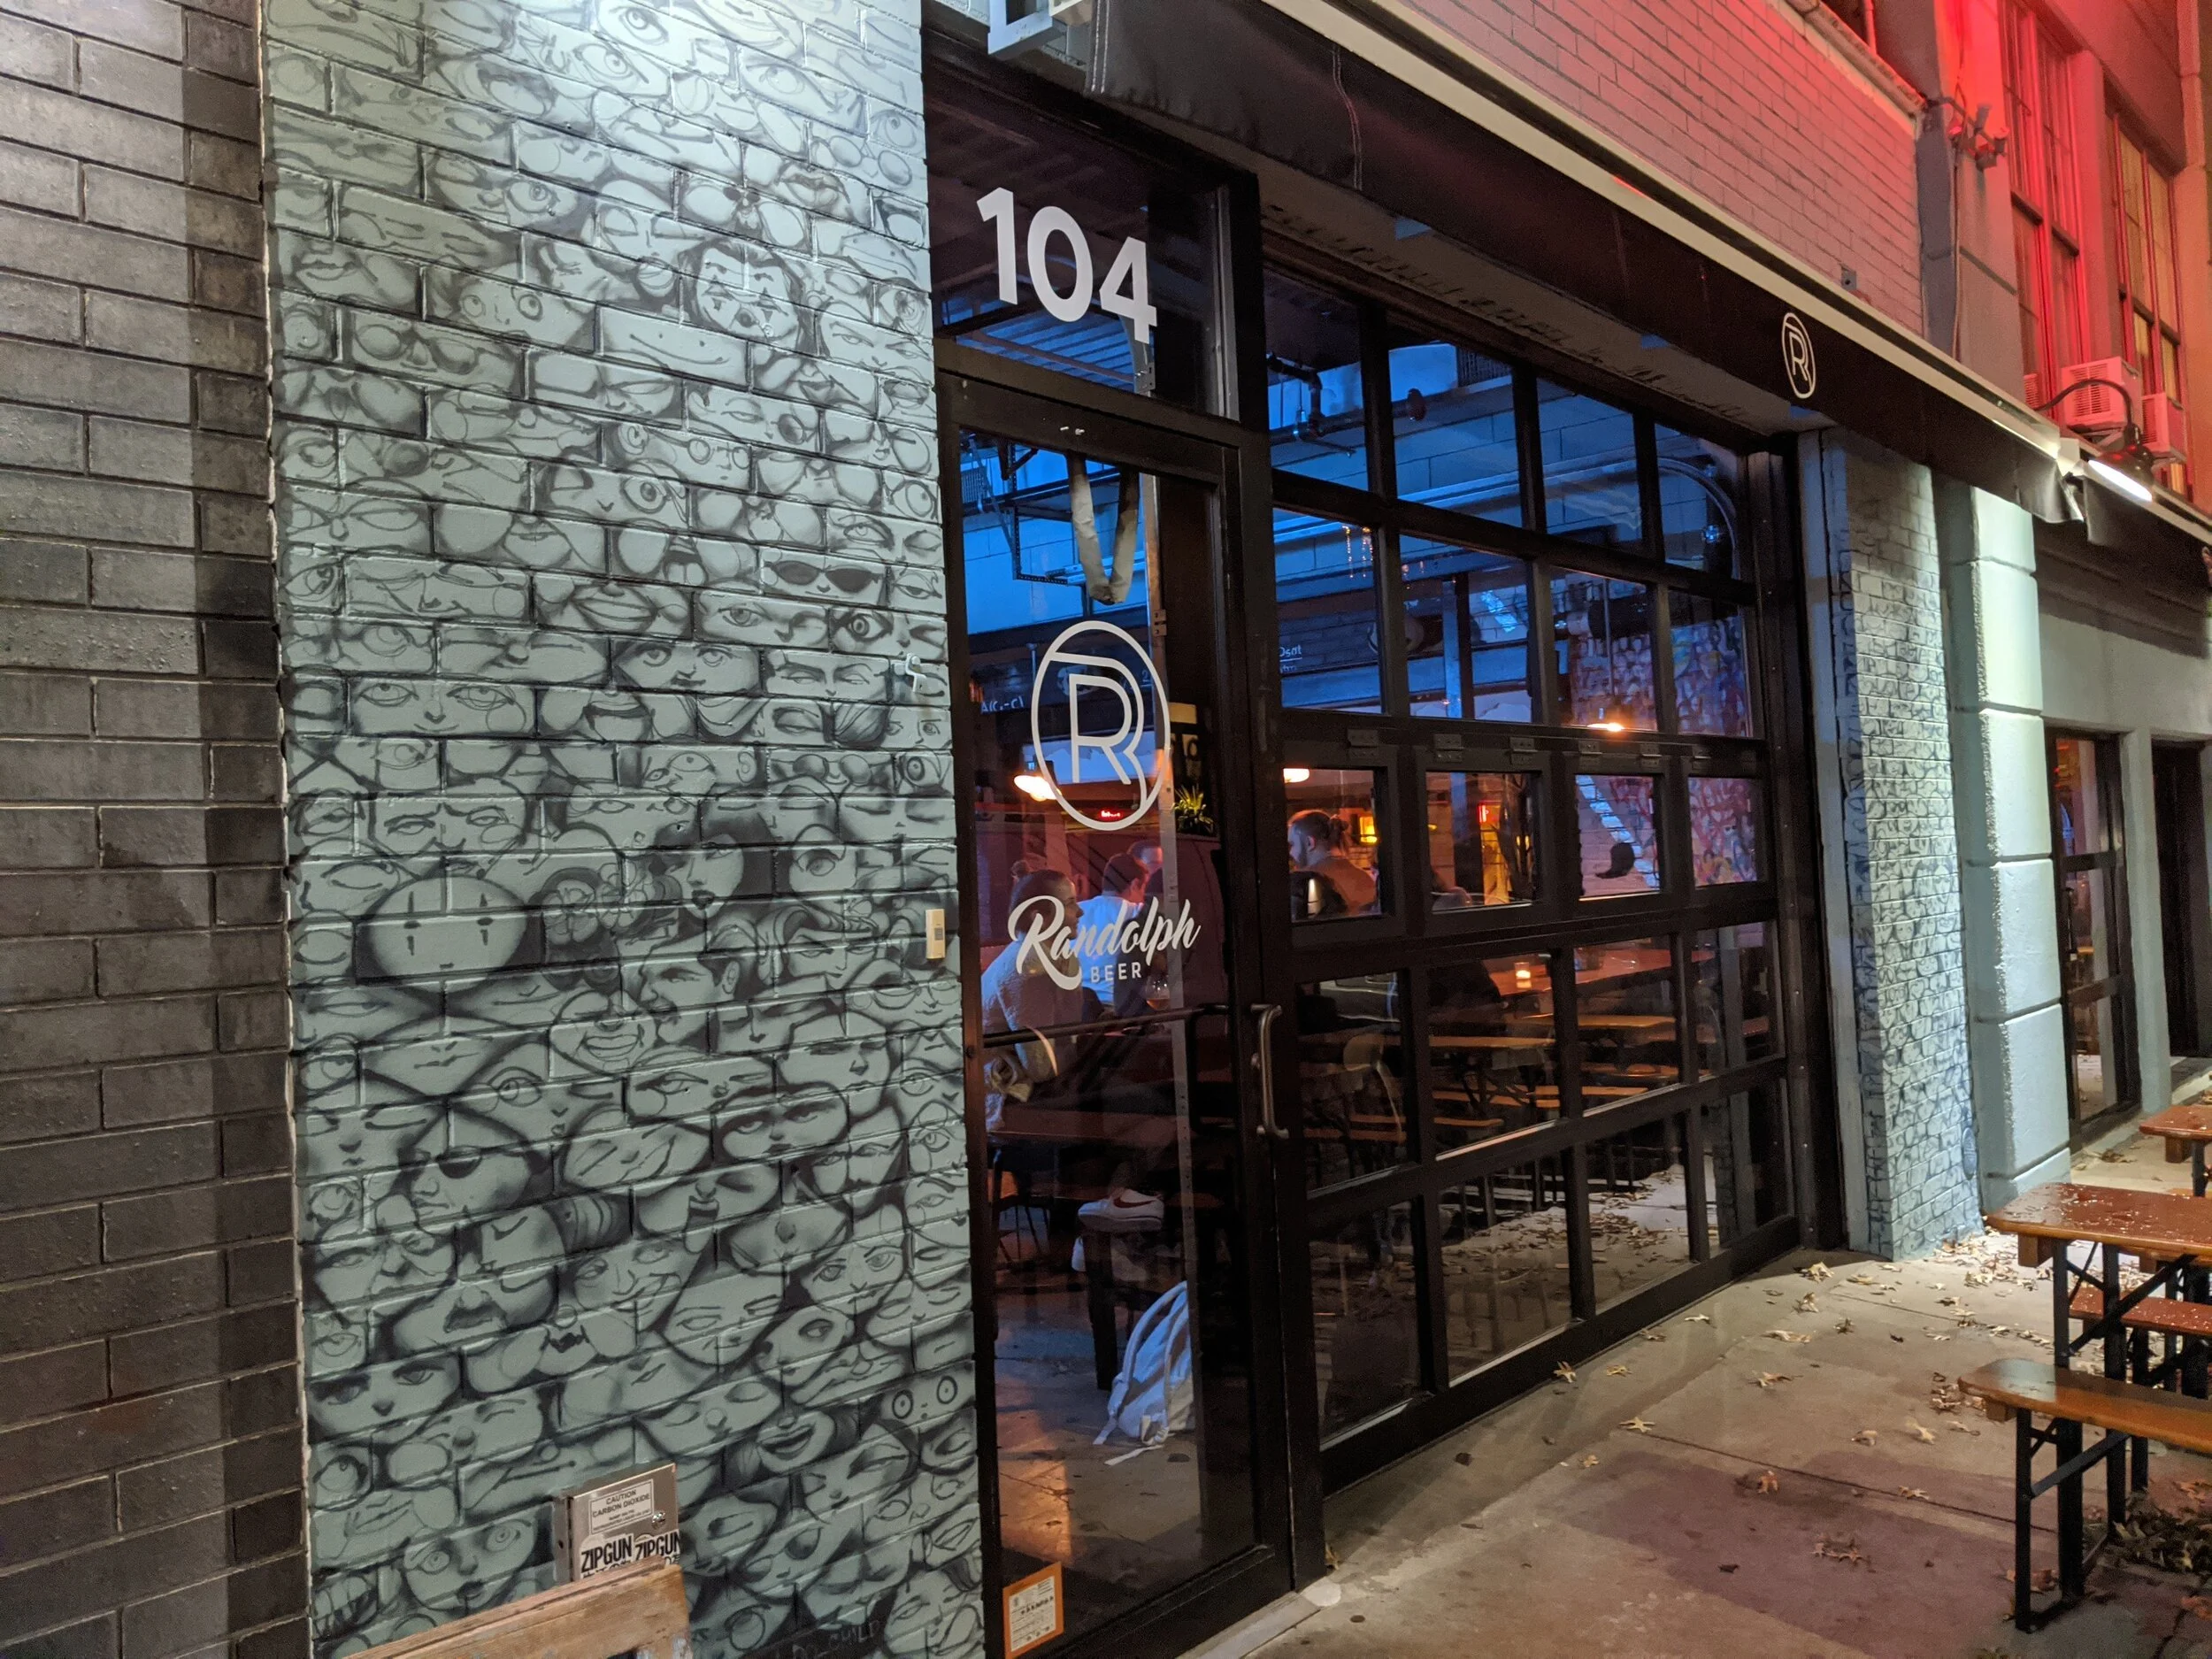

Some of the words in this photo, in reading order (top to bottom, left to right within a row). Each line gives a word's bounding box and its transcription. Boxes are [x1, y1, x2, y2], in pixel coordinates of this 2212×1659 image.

[976, 187, 1157, 344] 104
[1007, 895, 1202, 990] Randolph
[1090, 962, 1141, 983] BEER
[592, 1502, 622, 1517] CARBON
[623, 1493, 650, 1508] DIOXIDE
[606, 1489, 636, 1504] CAUTION
[580, 1535, 633, 1573] ZIPGUN
